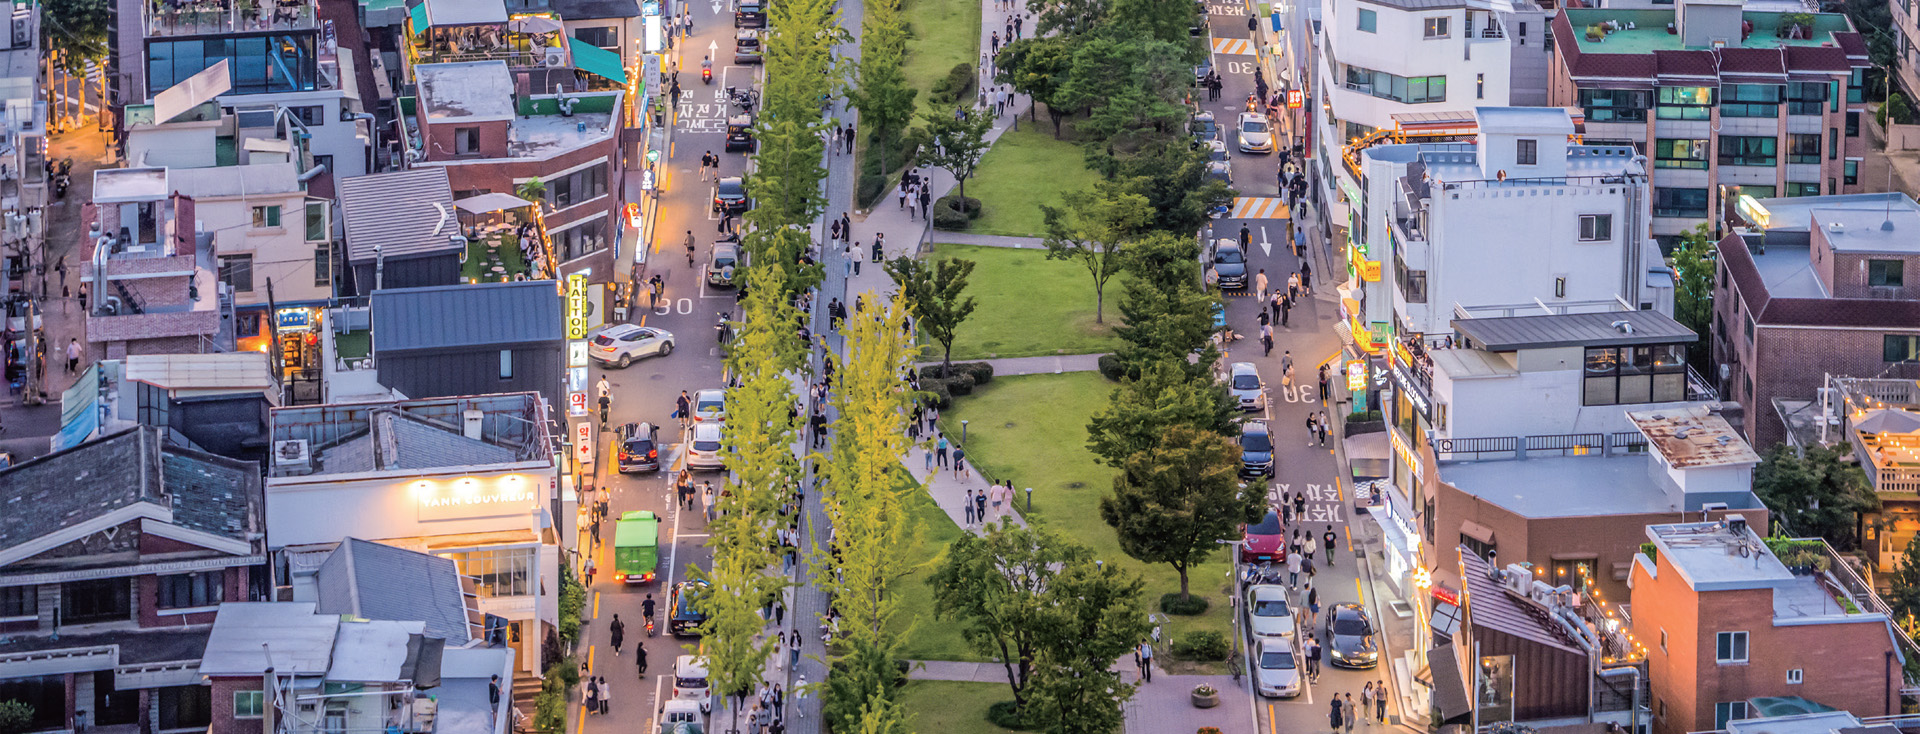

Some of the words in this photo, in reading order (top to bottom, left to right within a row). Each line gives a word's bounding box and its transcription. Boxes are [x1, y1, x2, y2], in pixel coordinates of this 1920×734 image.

[1228, 61, 1254, 75] 30
[678, 103, 728, 118] 자전거
[571, 278, 581, 336] TATTOO
[655, 297, 693, 316] 30
[571, 393, 586, 410] 약
